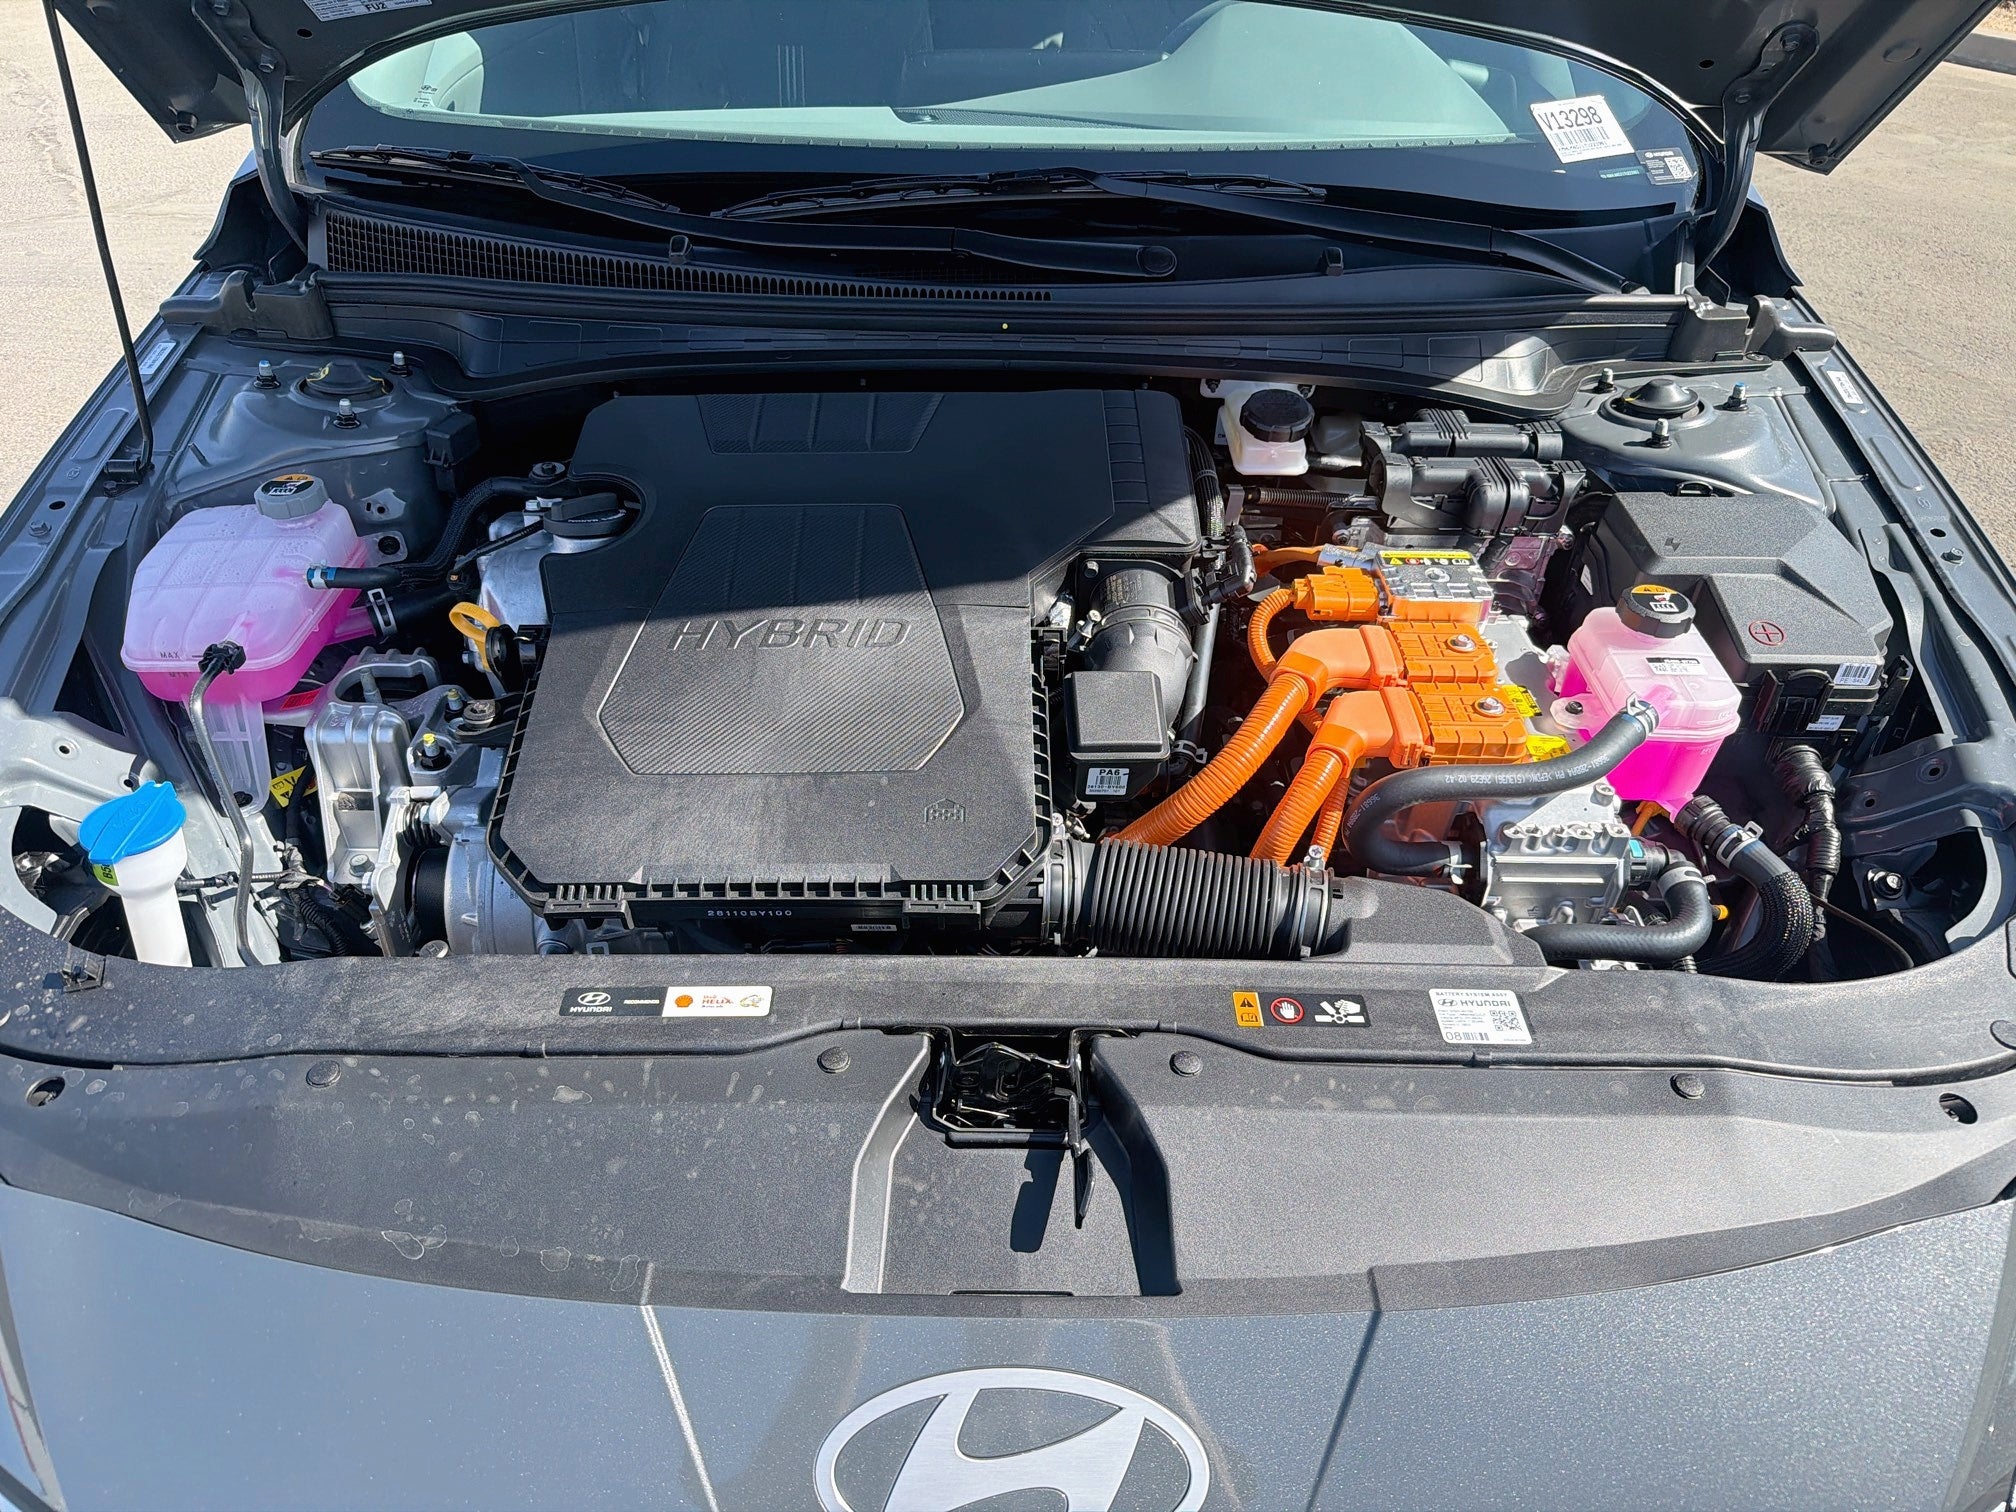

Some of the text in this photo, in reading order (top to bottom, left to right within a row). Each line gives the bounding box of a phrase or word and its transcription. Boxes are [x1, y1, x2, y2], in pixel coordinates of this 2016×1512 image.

[365, 2, 388, 12] FU2
[1538, 106, 1602, 131] V13298
[666, 618, 911, 650] HYBRID
[160, 651, 180, 659] MAX
[1446, 1032, 1462, 1040] 08
